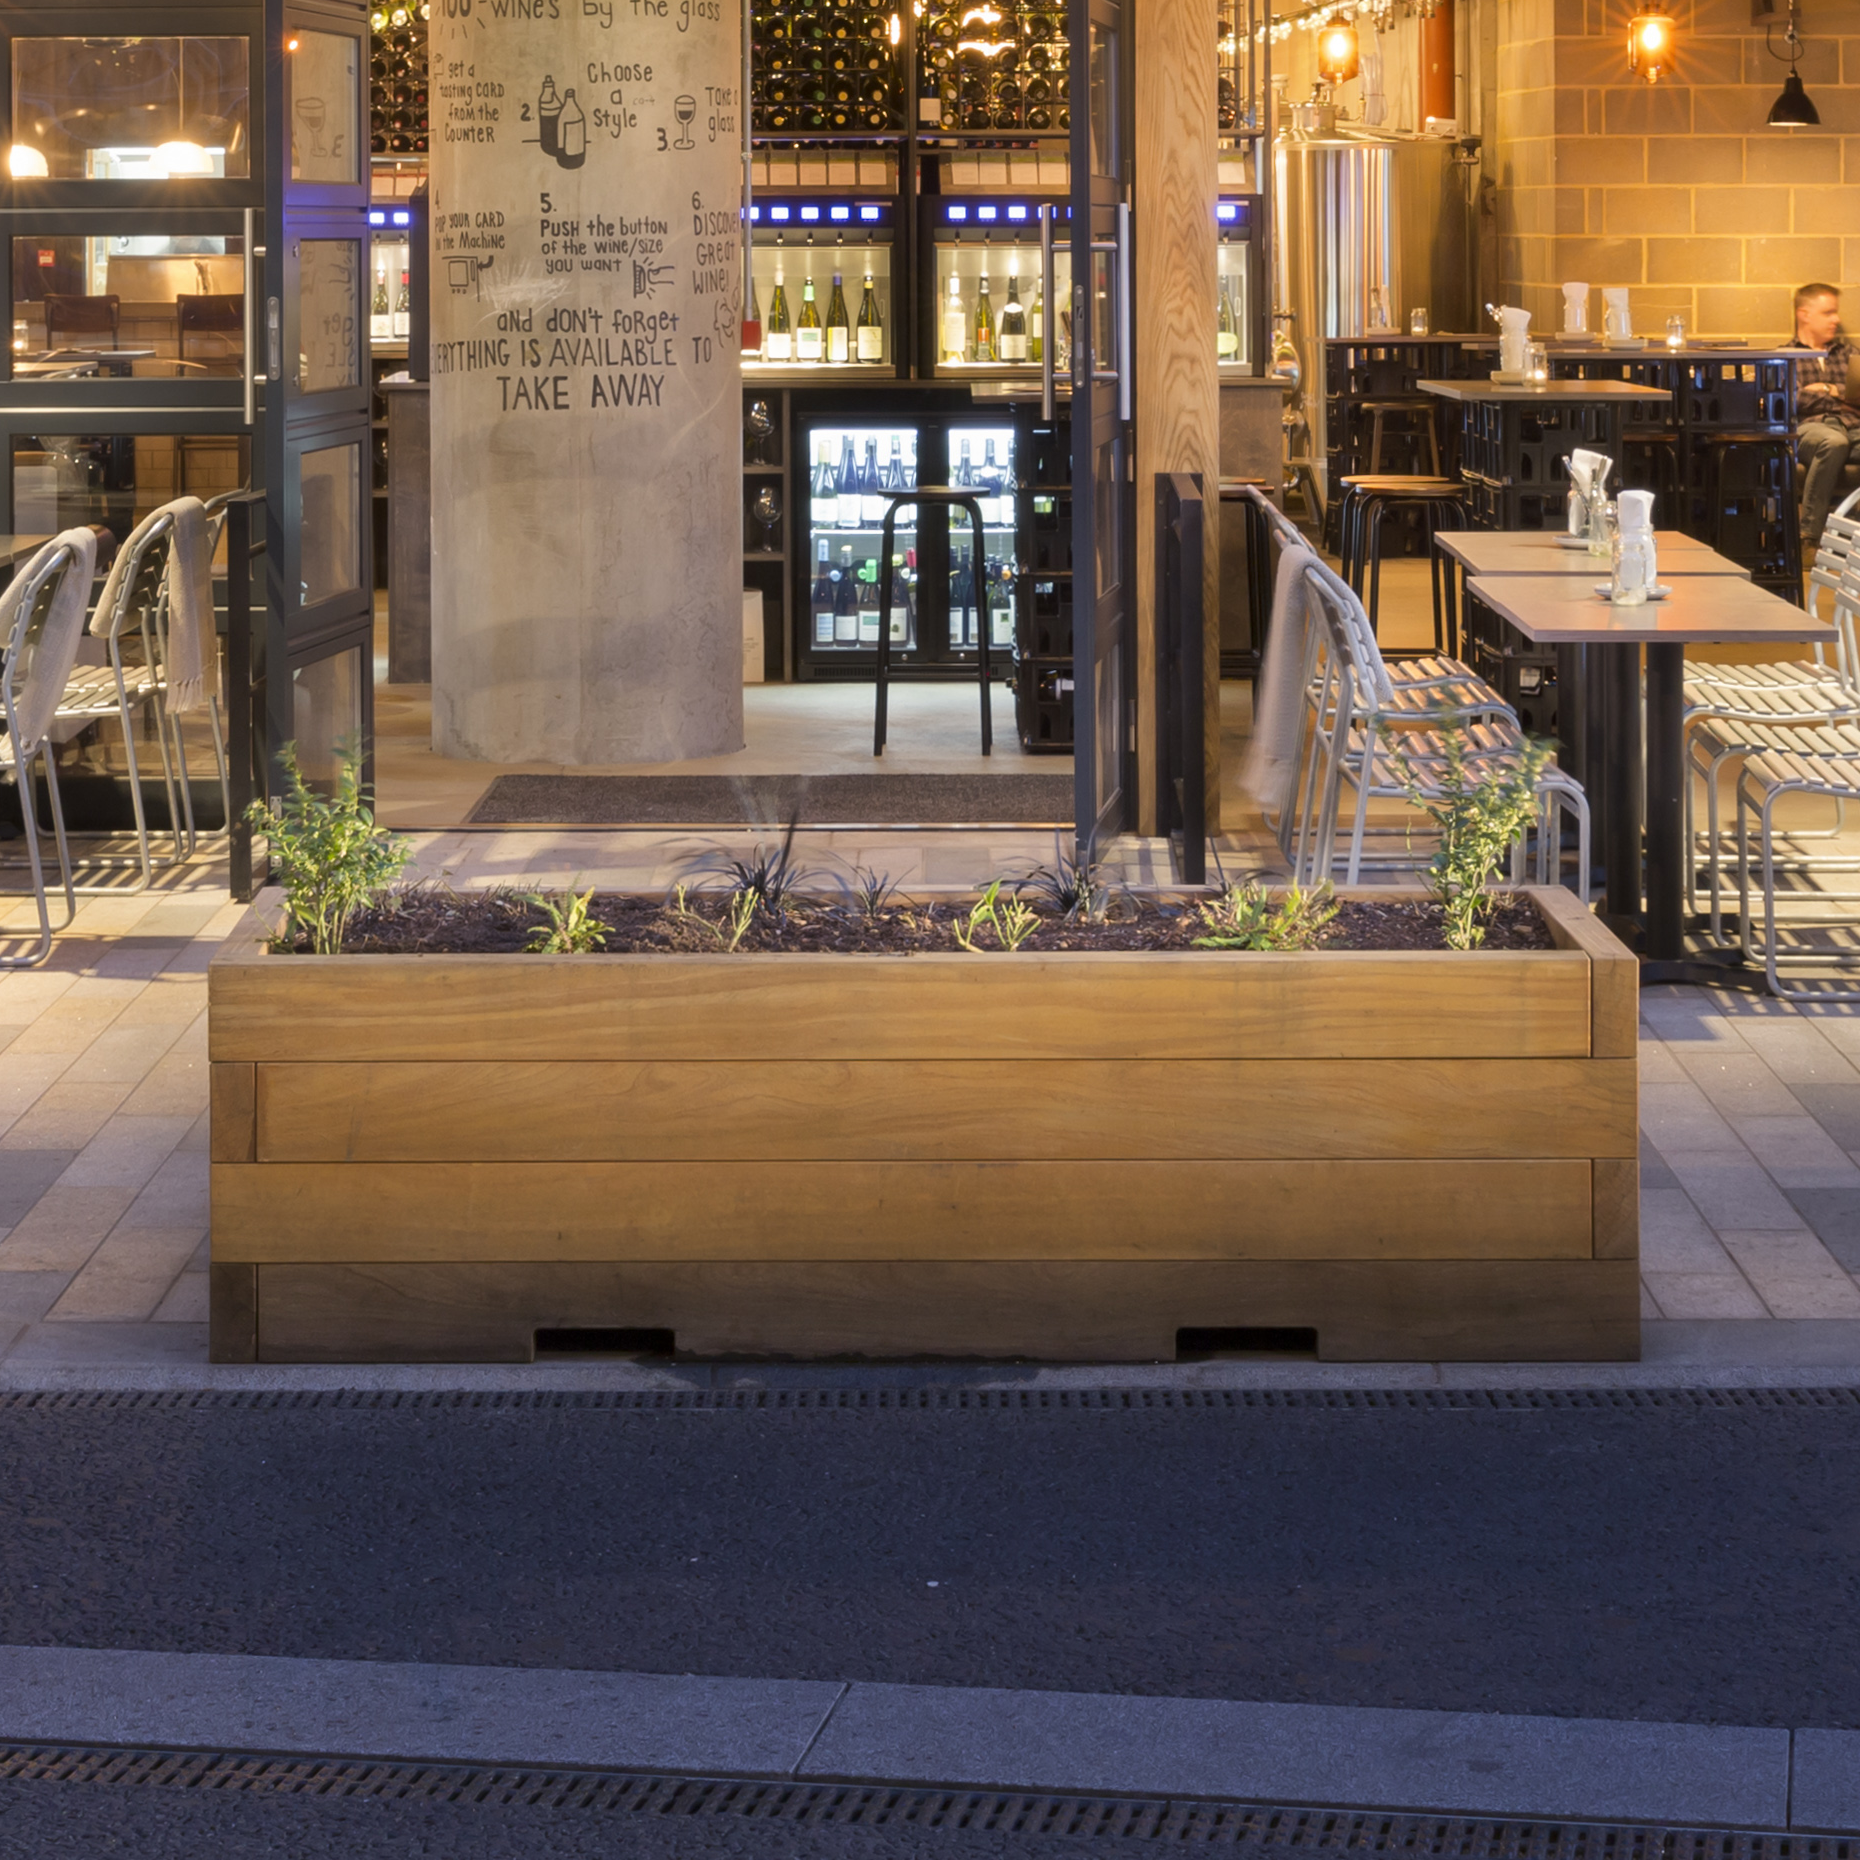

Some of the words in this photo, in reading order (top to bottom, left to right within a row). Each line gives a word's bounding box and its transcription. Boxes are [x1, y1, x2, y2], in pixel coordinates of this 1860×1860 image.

[448, 60, 465, 79] get
[467, 64, 475, 78] a
[587, 61, 653, 83] Choose
[610, 88, 623, 105] a
[478, 102, 500, 121] the
[520, 103, 535, 122] 2.
[593, 107, 638, 139] Style
[708, 108, 735, 143] glass
[656, 127, 671, 151] 3.
[540, 192, 557, 213] 5.
[691, 191, 705, 211] 6.
[475, 210, 505, 228] CARD
[586, 214, 615, 236] the
[442, 233, 455, 250] the
[541, 240, 558, 255] of
[562, 238, 587, 255] the
[521, 338, 541, 368] IS
[549, 338, 677, 367] AVAILABLE
[692, 337, 712, 364] TO
[497, 376, 570, 411] TAKE
[591, 374, 664, 408] AWAY
